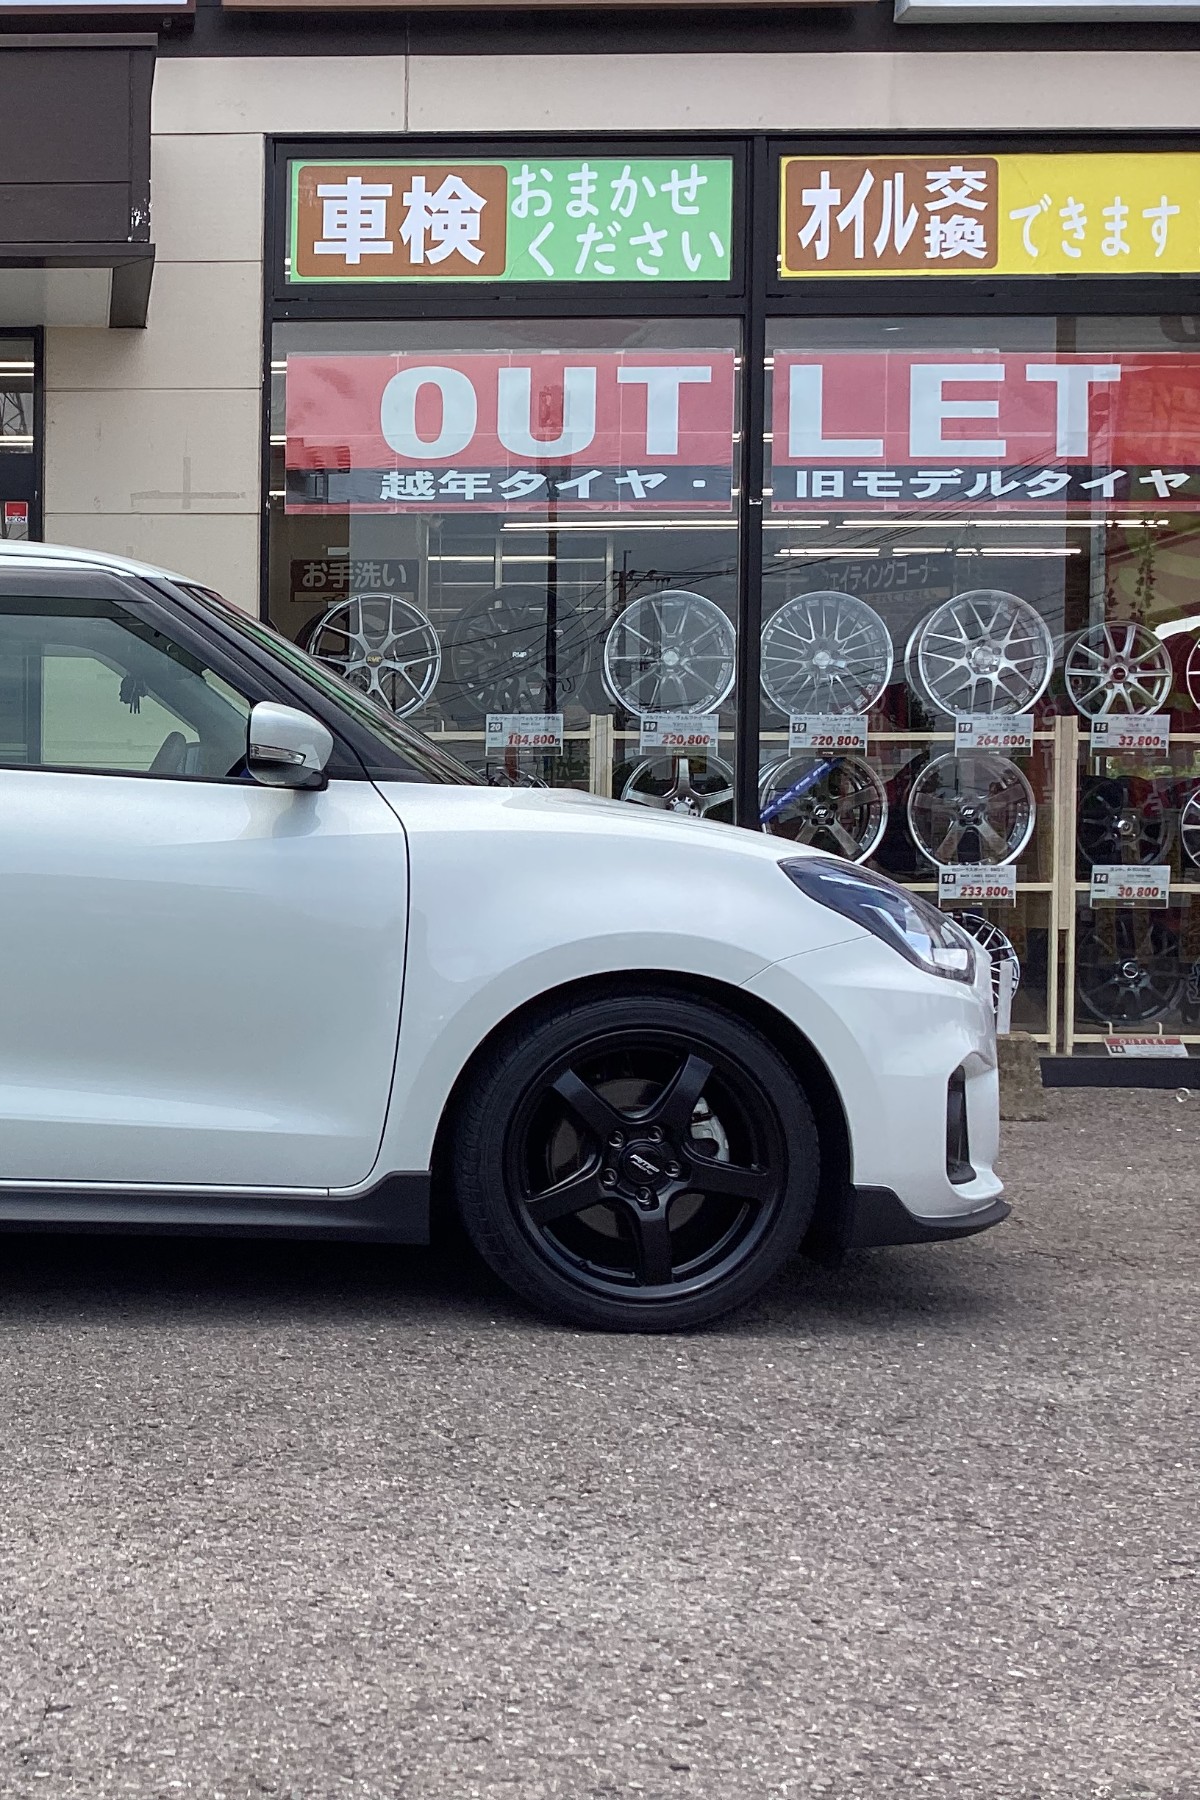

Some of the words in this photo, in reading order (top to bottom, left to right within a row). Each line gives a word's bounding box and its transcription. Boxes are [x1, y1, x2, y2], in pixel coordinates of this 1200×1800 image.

[511, 163, 709, 219] おまかせ
[313, 176, 488, 265] 車検
[797, 168, 919, 260] オイル
[923, 164, 989, 261] 交換
[1010, 194, 1182, 259] できます
[525, 221, 725, 277] ください
[379, 365, 713, 461] OUT
[795, 470, 1190, 500] 旧モデルタイヤ
[302, 562, 407, 589] お手洗い
[490, 723, 501, 731] 20
[794, 723, 805, 731] 19
[960, 723, 971, 731] 19
[1096, 723, 1107, 731] 15
[943, 874, 954, 883] 18
[1096, 874, 1107, 883] 14
